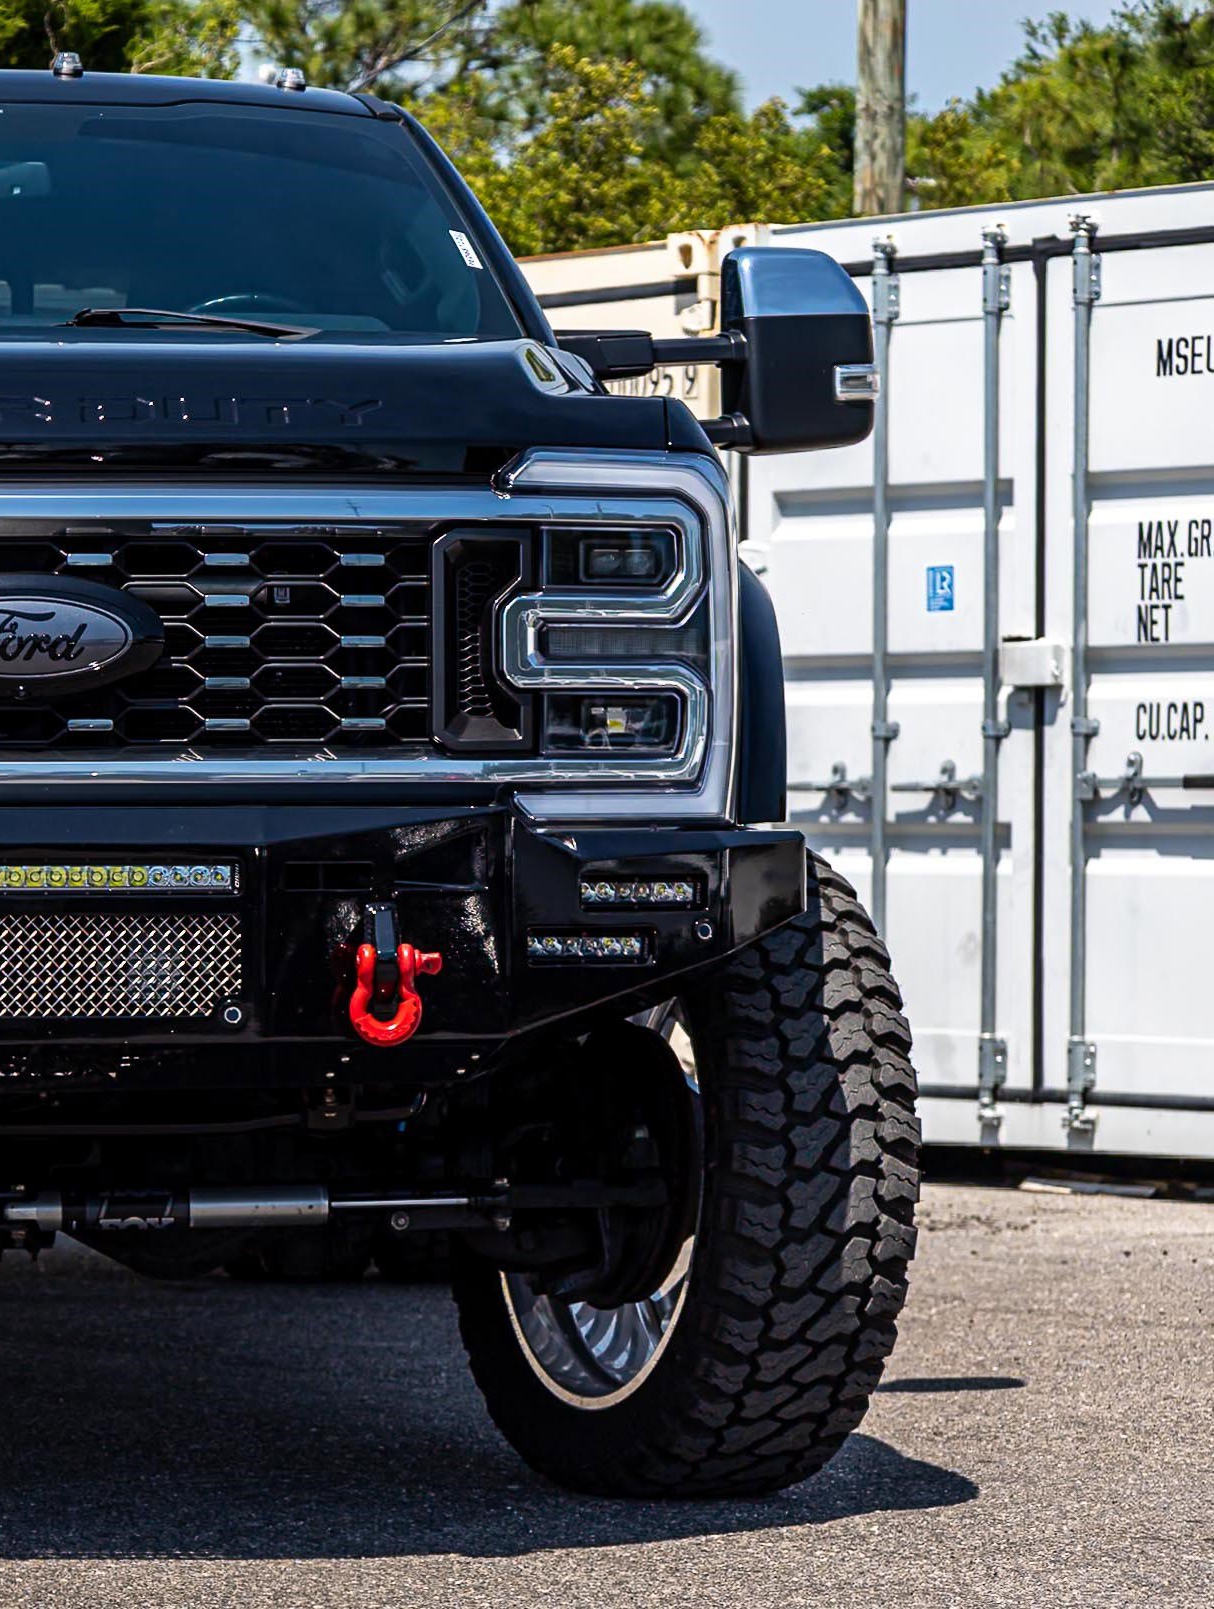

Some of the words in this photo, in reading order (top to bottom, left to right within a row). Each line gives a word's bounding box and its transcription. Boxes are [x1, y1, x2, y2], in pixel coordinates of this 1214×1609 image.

[1156, 335, 1214, 377] MSEU
[80, 396, 381, 426] DUTY
[1137, 519, 1214, 559] MAX.GR
[1137, 562, 1185, 601] TARE
[1137, 604, 1172, 642] NET
[1136, 702, 1209, 740] CU.CAP.
